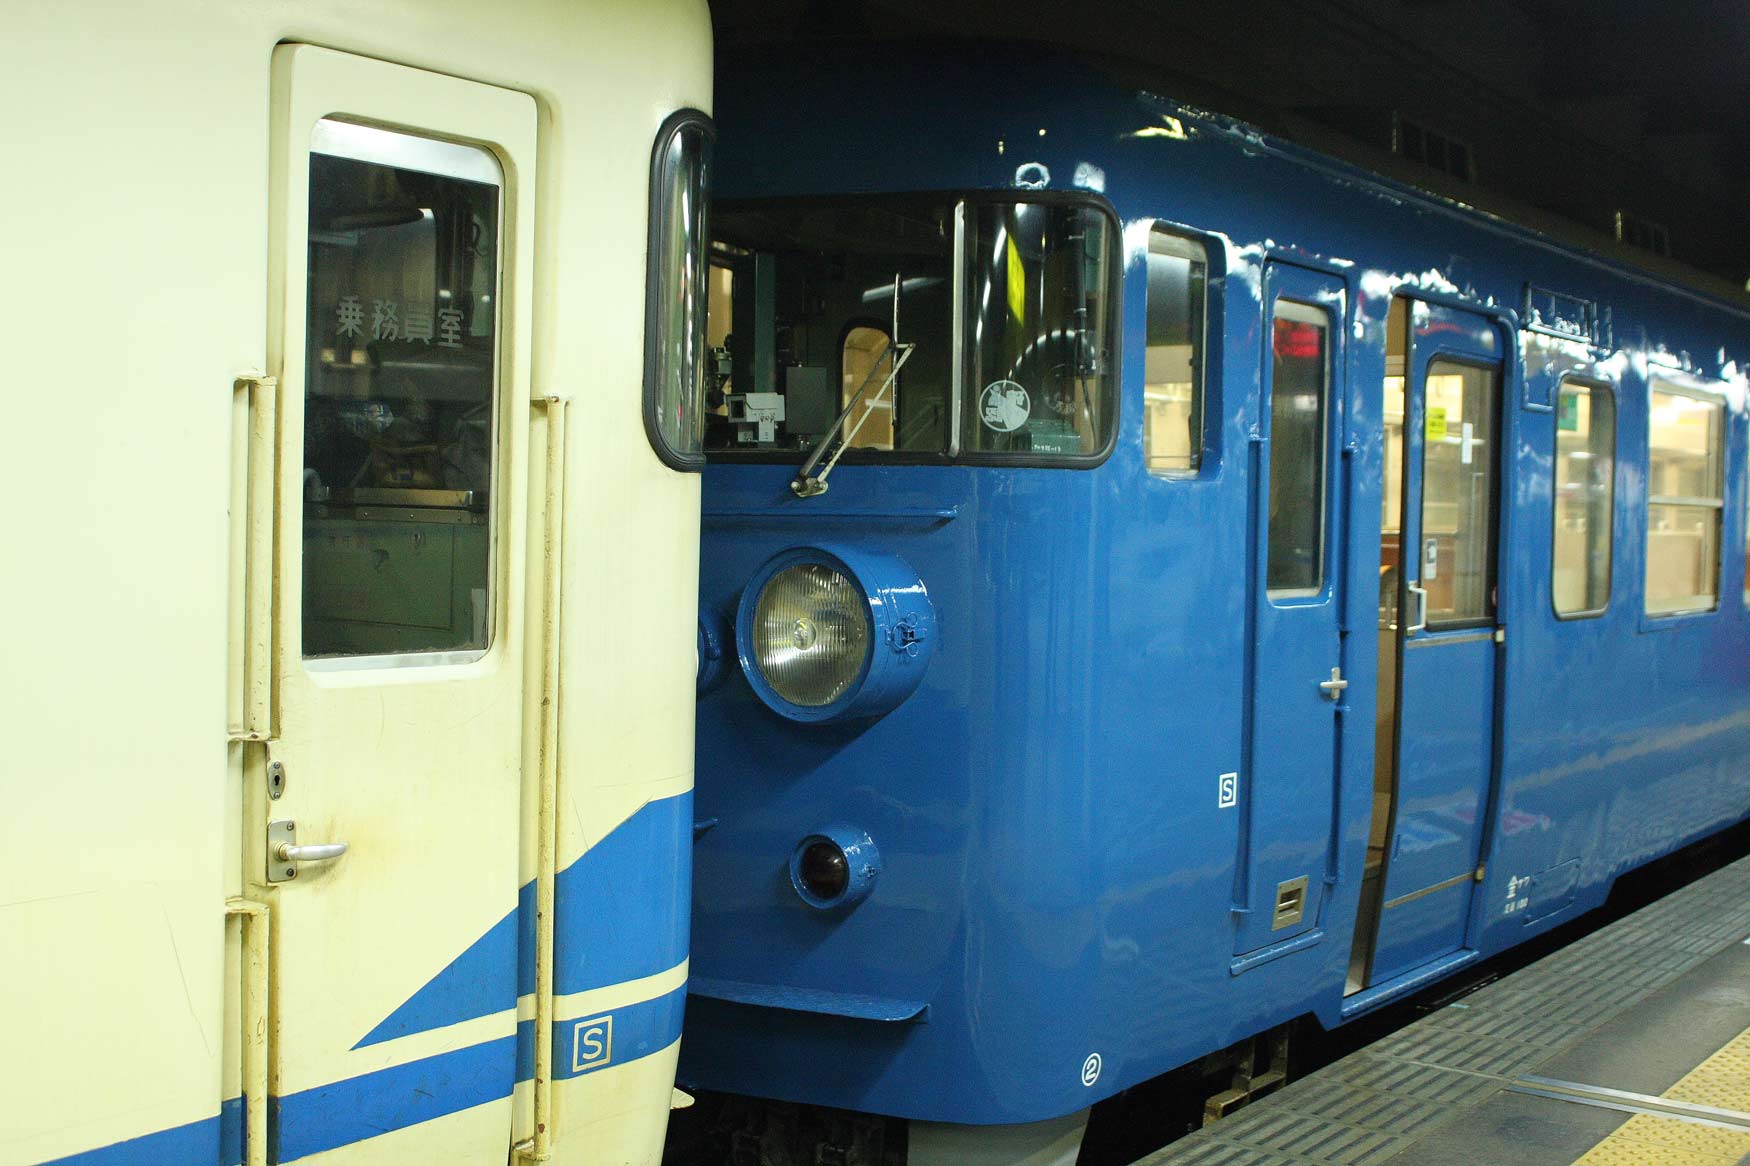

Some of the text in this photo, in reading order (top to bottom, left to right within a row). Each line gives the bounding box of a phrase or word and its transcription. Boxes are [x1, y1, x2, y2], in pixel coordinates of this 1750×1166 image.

[336, 295, 465, 348] 乗務員室
[1222, 779, 1233, 801] S
[582, 1027, 603, 1060] S
